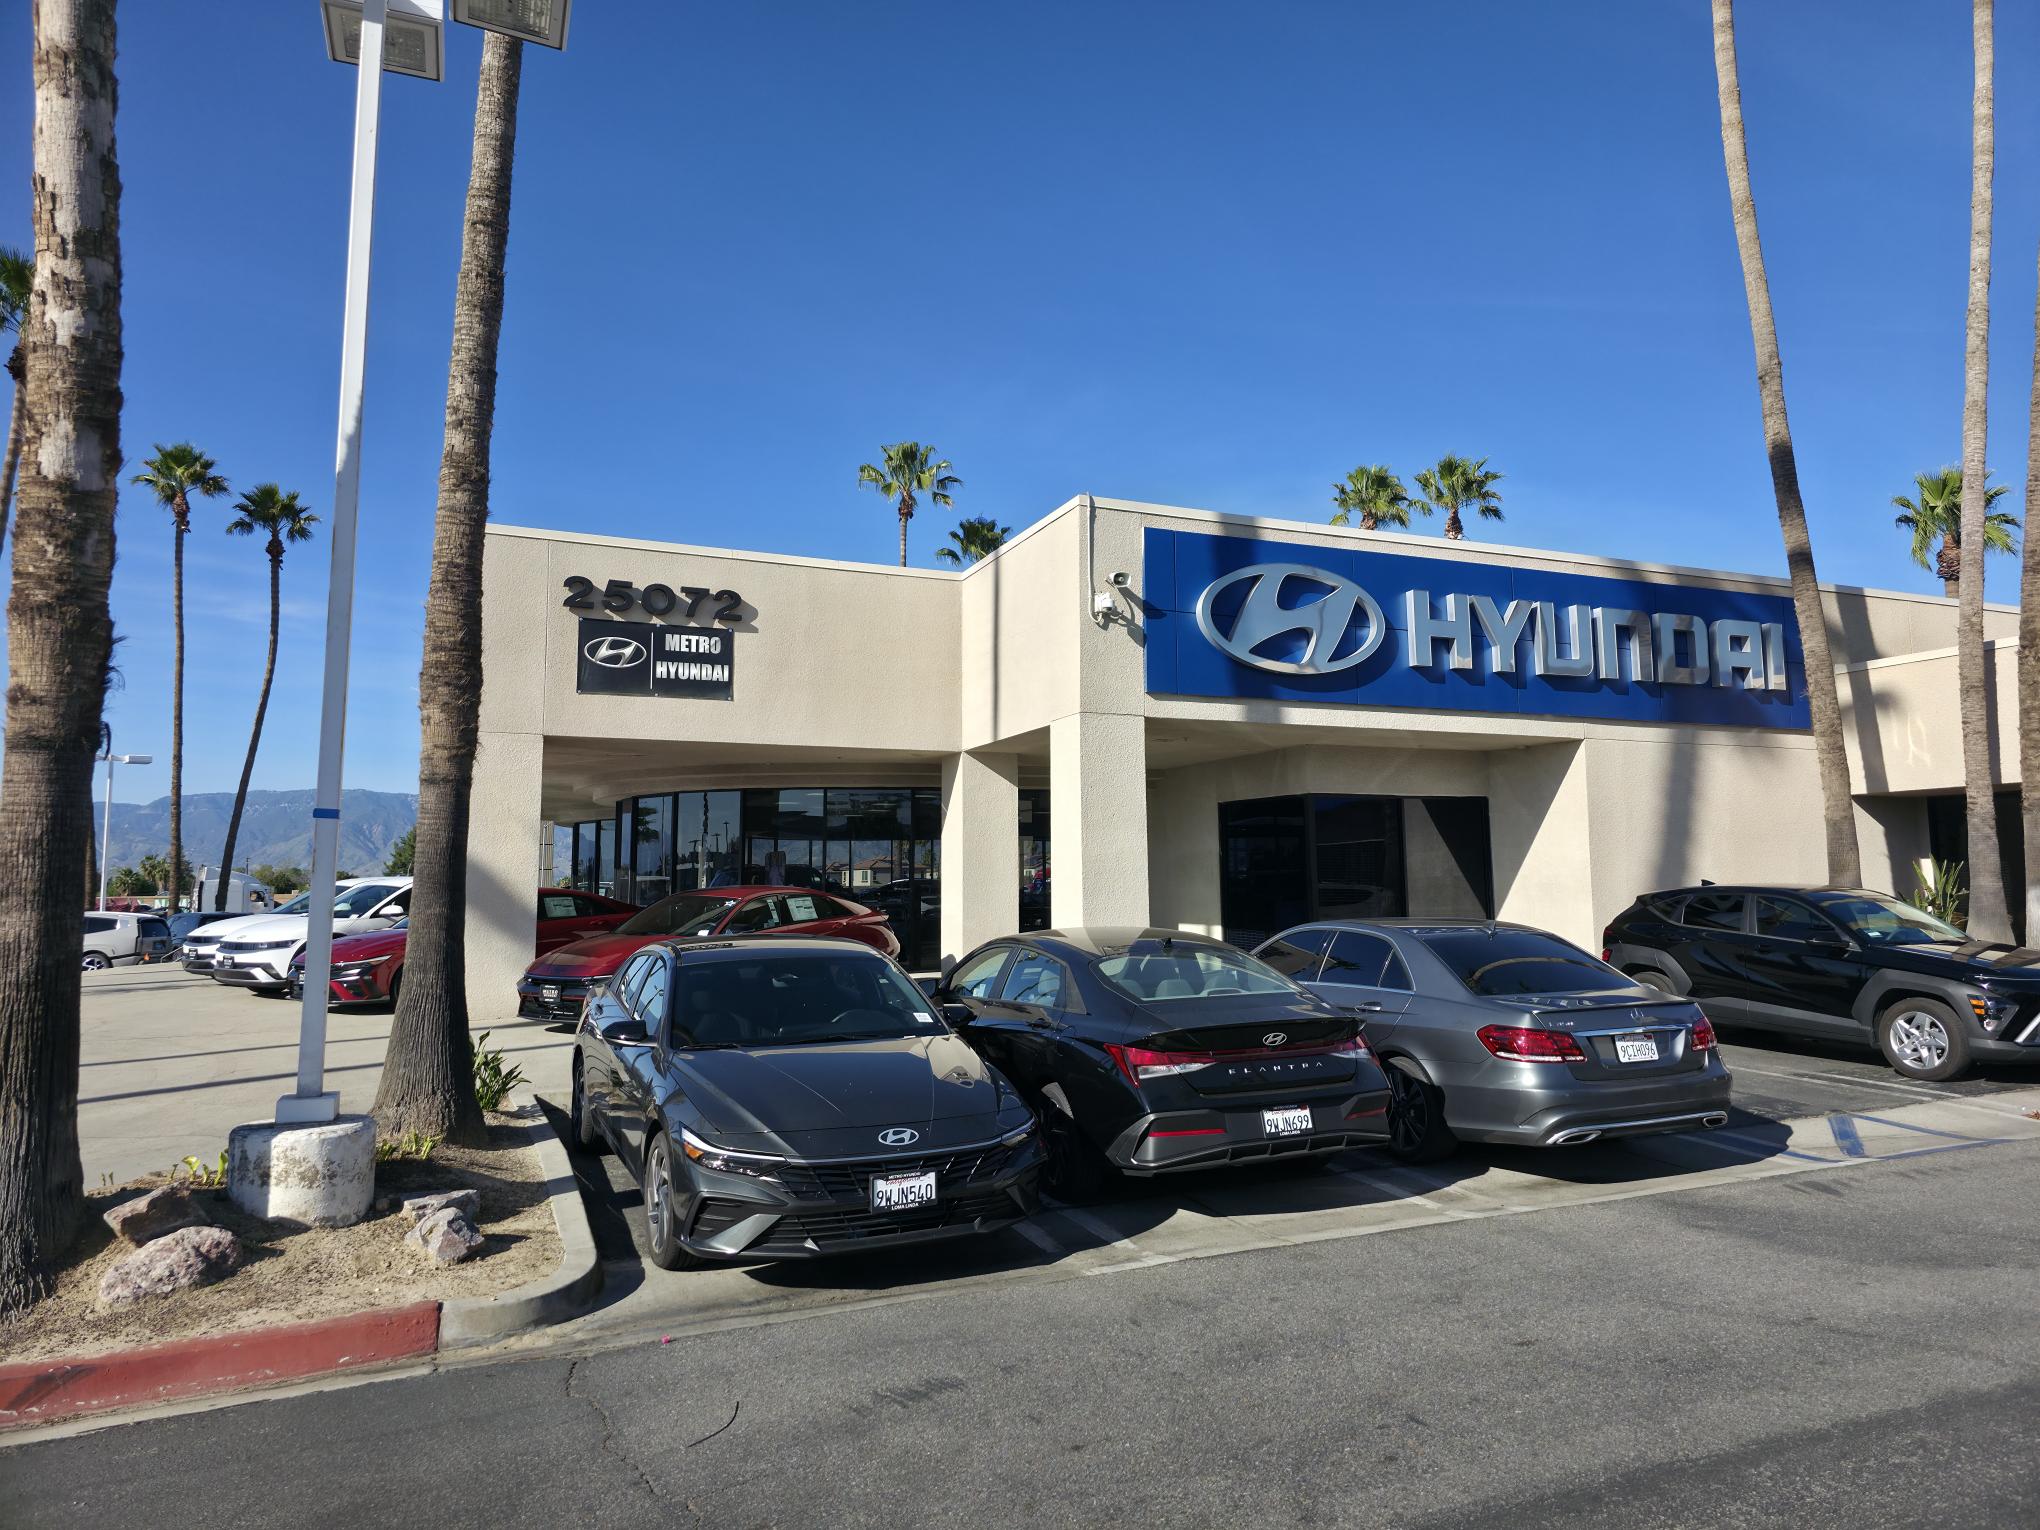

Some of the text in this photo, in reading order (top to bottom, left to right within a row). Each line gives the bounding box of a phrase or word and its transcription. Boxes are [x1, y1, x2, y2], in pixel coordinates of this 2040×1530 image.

[563, 575, 742, 621] 25072
[665, 633, 722, 655] METRO
[1405, 588, 1787, 691] HYUNDAI
[655, 660, 730, 682] HYUNDAI
[1620, 1043, 1656, 1058] 9CIH096
[1228, 1062, 1323, 1075] ELANTRA
[1266, 1114, 1309, 1132] 9WJN699
[876, 1183, 933, 1206] 9WJN540
